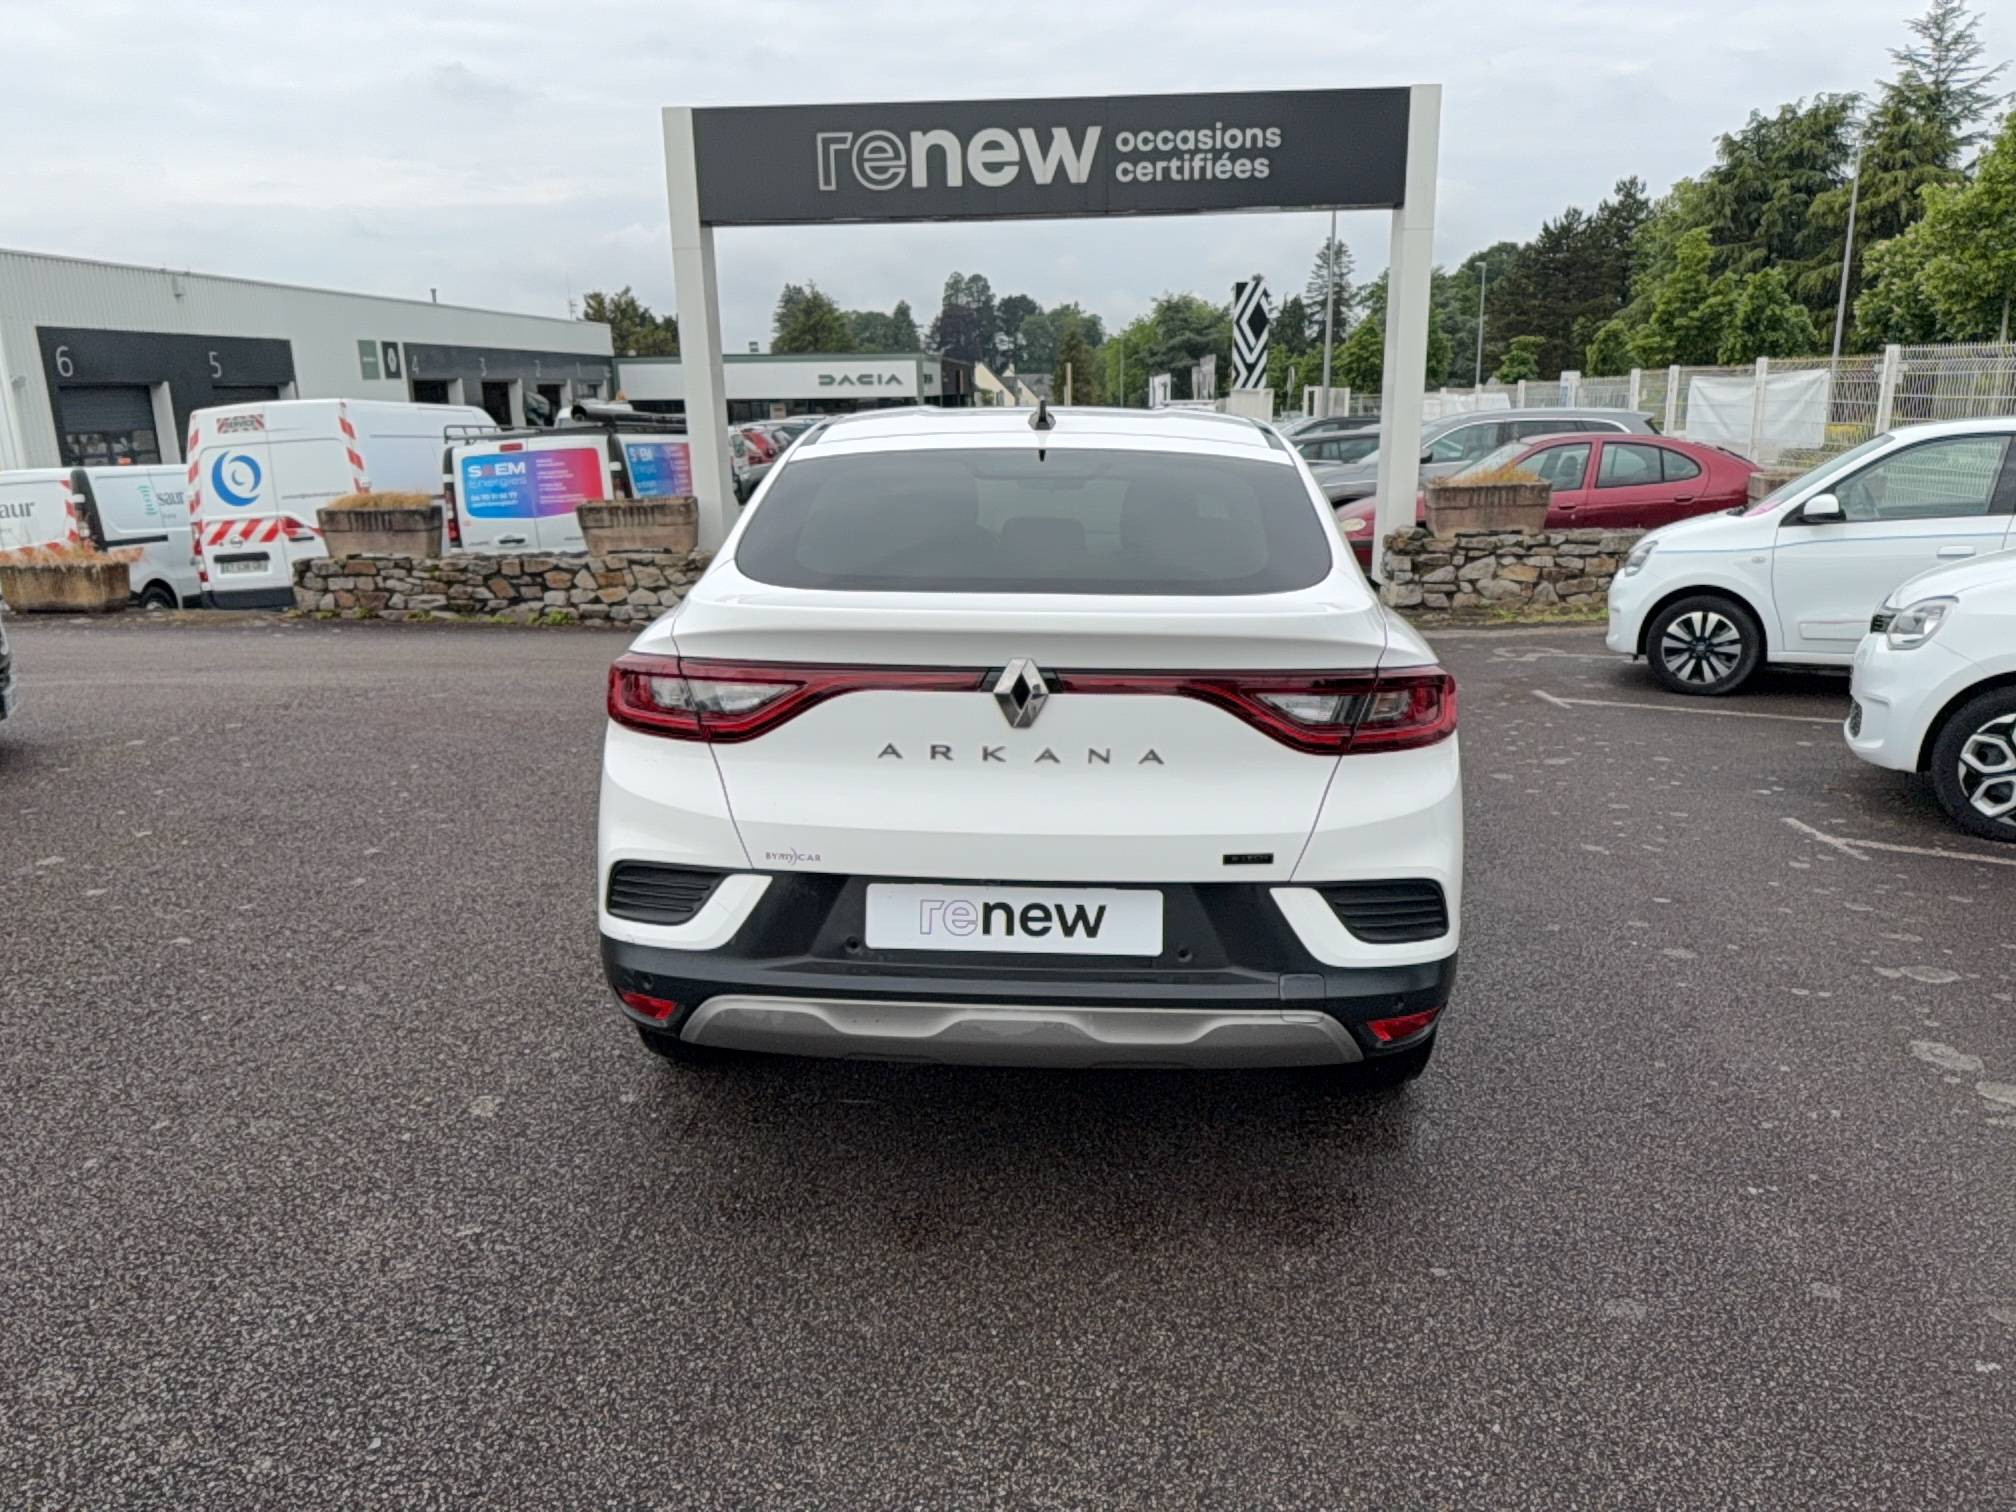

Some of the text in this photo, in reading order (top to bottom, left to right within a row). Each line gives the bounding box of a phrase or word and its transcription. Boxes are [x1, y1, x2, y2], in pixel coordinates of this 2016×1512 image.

[1115, 122, 1282, 152] occasions
[816, 125, 1102, 191] renew
[1115, 152, 1270, 183] certifiées
[55, 345, 74, 377] 6
[208, 351, 222, 378] 5
[410, 354, 420, 375] 4
[479, 357, 488, 377] 3
[818, 373, 904, 387] DACIA
[156, 491, 184, 507] saur
[877, 743, 1165, 765] ARKANA
[919, 899, 1107, 938] renew
